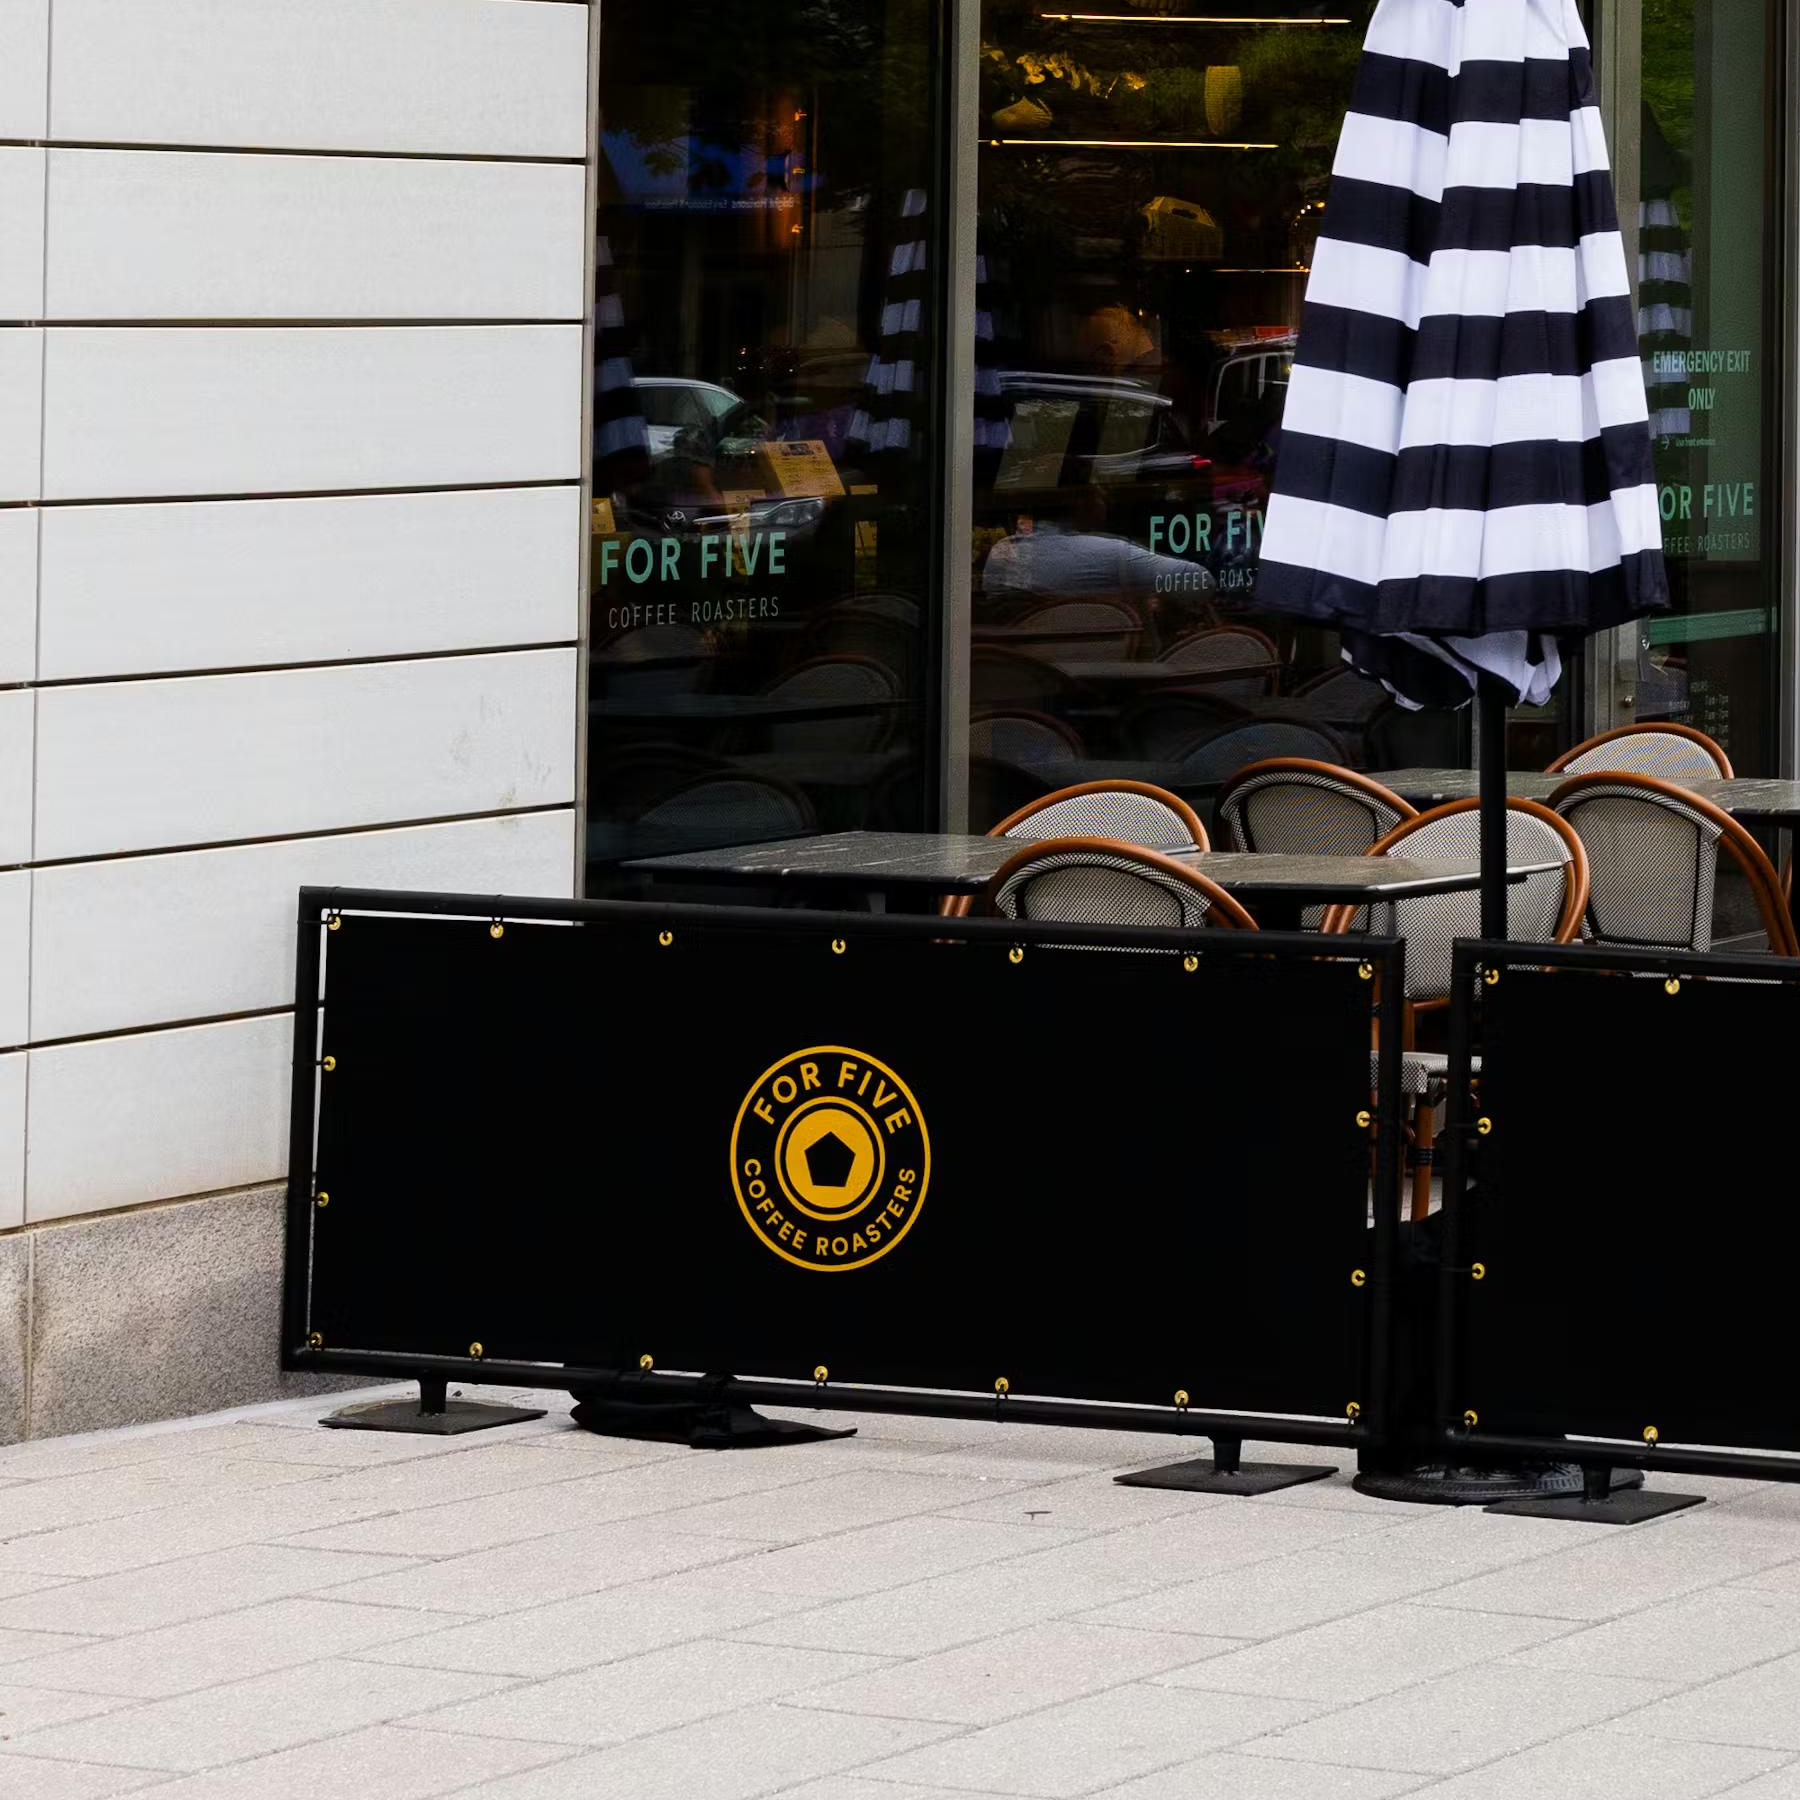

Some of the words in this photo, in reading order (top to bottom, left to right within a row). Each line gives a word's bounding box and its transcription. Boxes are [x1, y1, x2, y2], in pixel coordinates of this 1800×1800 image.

[1653, 350, 1724, 373] EMERGENCY
[1727, 350, 1750, 373] EXIT
[1688, 388, 1715, 410] ONLY
[1659, 486, 1692, 521] OR
[1703, 483, 1754, 518] FIVE
[1150, 513, 1212, 554] FOR
[1227, 510, 1266, 550] FIV
[1663, 536, 1690, 553] FFEE
[1698, 532, 1750, 552] ROASTERS
[601, 537, 681, 586] FOR
[701, 532, 786, 579] FIVE
[1155, 571, 1209, 593] COFFEE
[1219, 568, 1259, 590] ROAS
[608, 604, 677, 629] COFFEE
[692, 596, 779, 623] ROASTERS
[753, 1061, 822, 1125] FOR
[837, 1061, 912, 1134] FIVE
[744, 1158, 808, 1250] COFFEE
[816, 1167, 916, 1256] ROASTERS
